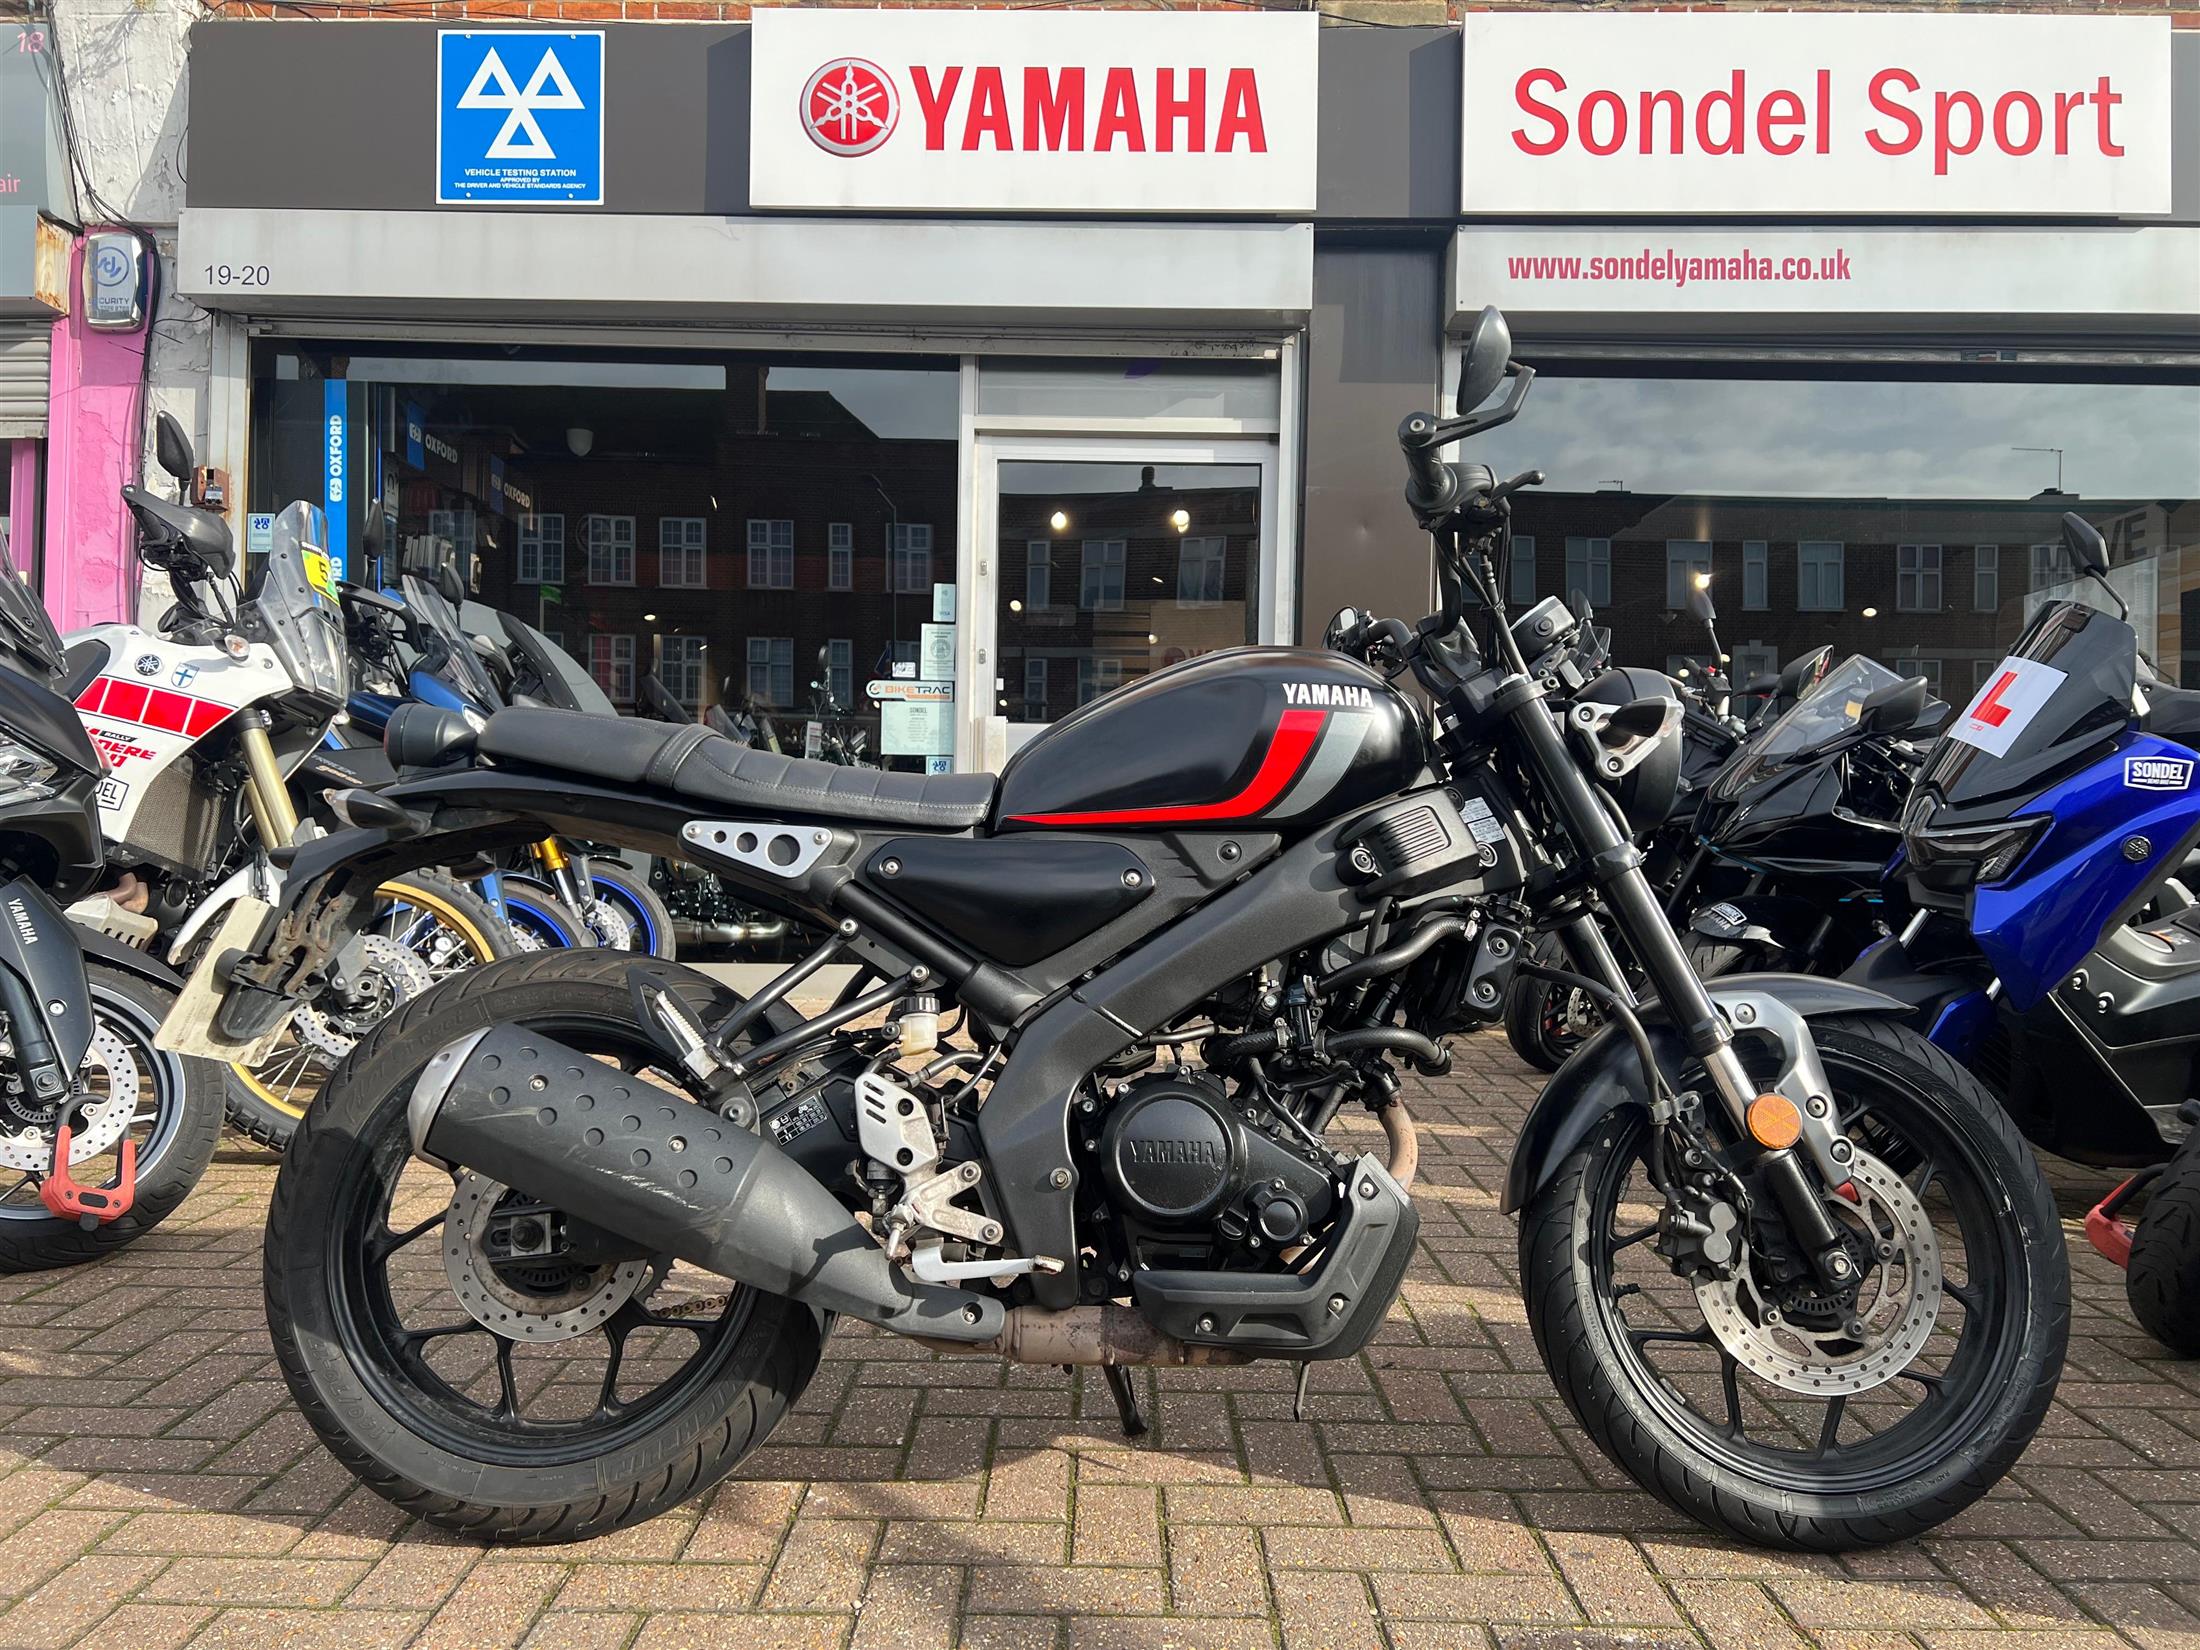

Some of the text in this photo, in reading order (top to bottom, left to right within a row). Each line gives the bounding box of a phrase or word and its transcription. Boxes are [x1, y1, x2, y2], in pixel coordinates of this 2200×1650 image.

[17, 31, 44, 53] 18
[908, 65, 1269, 153] YAMAHA
[1511, 67, 2126, 176] Sondel Sport
[464, 168, 577, 177] VEHICLE TESTING STATION
[204, 264, 271, 287] 19-20
[1508, 248, 1852, 288] www.sondelyamaha.co.uk
[329, 413, 343, 477] OXFORD
[424, 433, 458, 464] OXFORD
[503, 482, 531, 508] OXFORD
[884, 685, 951, 694] BIKETRAC
[1282, 682, 1375, 708] YAMAHA
[1969, 671, 2013, 728] L
[104, 731, 132, 741] RALLY
[2132, 761, 2184, 780] SONDEL
[8, 897, 39, 945] YAMAHA
[1129, 1140, 1218, 1164] YAMAHA
